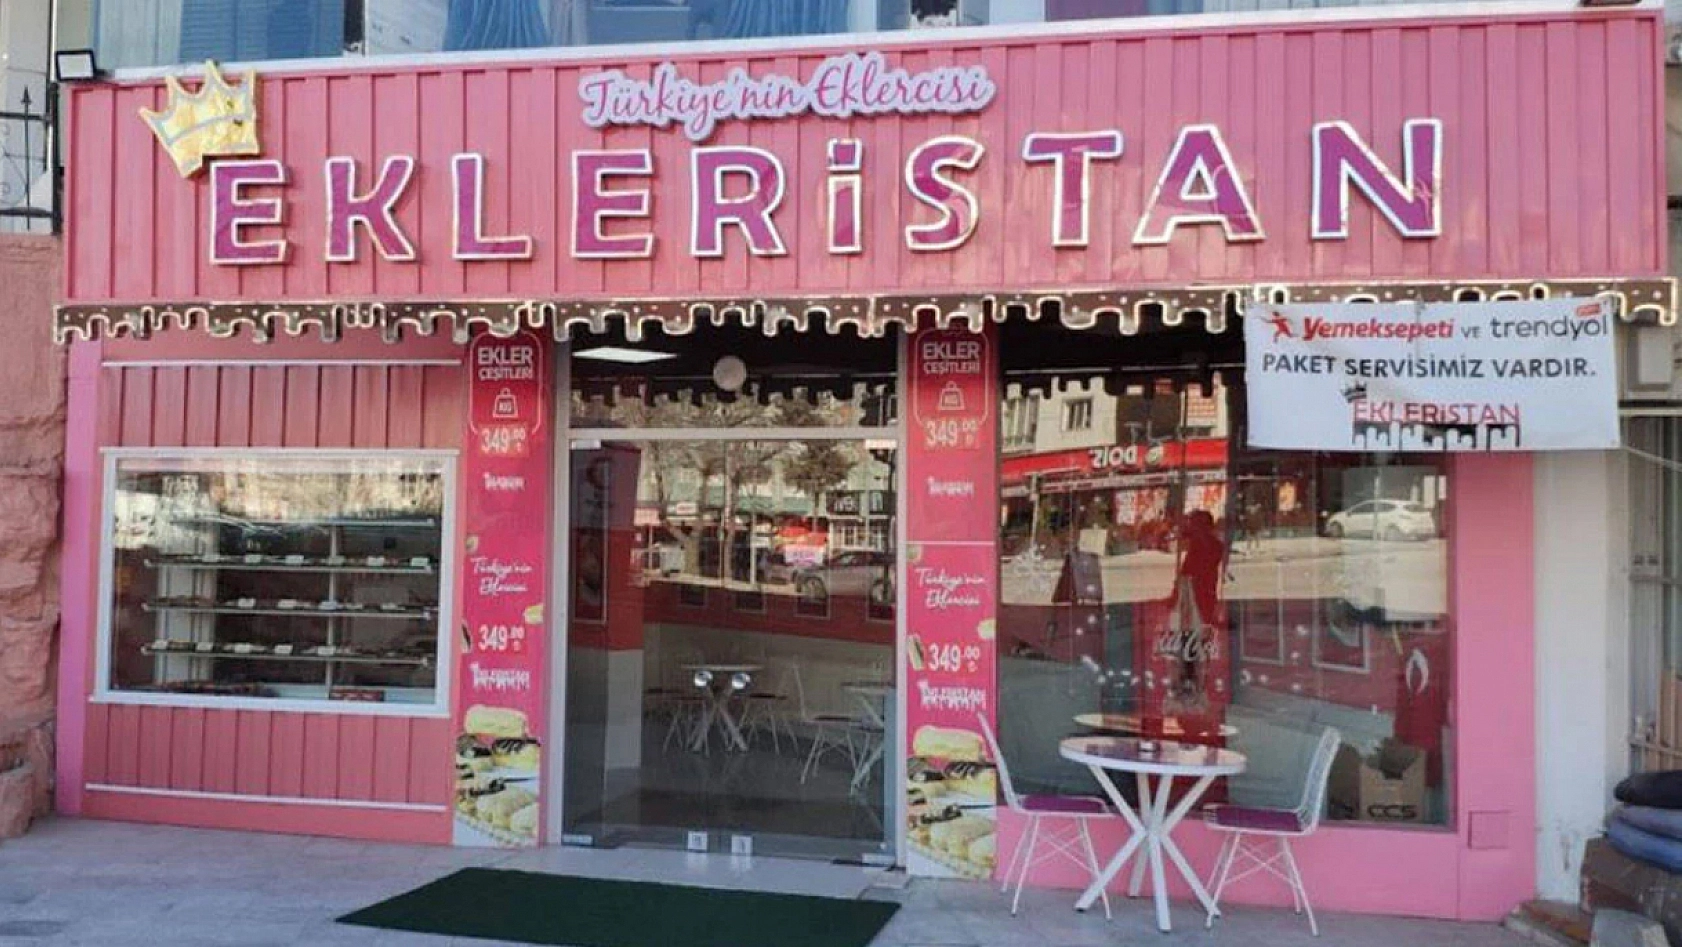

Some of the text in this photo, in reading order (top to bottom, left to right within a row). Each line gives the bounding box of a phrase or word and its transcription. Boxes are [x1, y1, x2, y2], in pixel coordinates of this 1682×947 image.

[582, 56, 991, 133] Türkiye'nin Eklercisi
[1303, 314, 1608, 342] Yemeksepeti VE trendyol
[477, 347, 533, 365] EKLER
[923, 341, 980, 360] EKLER
[1262, 353, 1597, 379] PAKET SERVİSİMİZ VARDIR.
